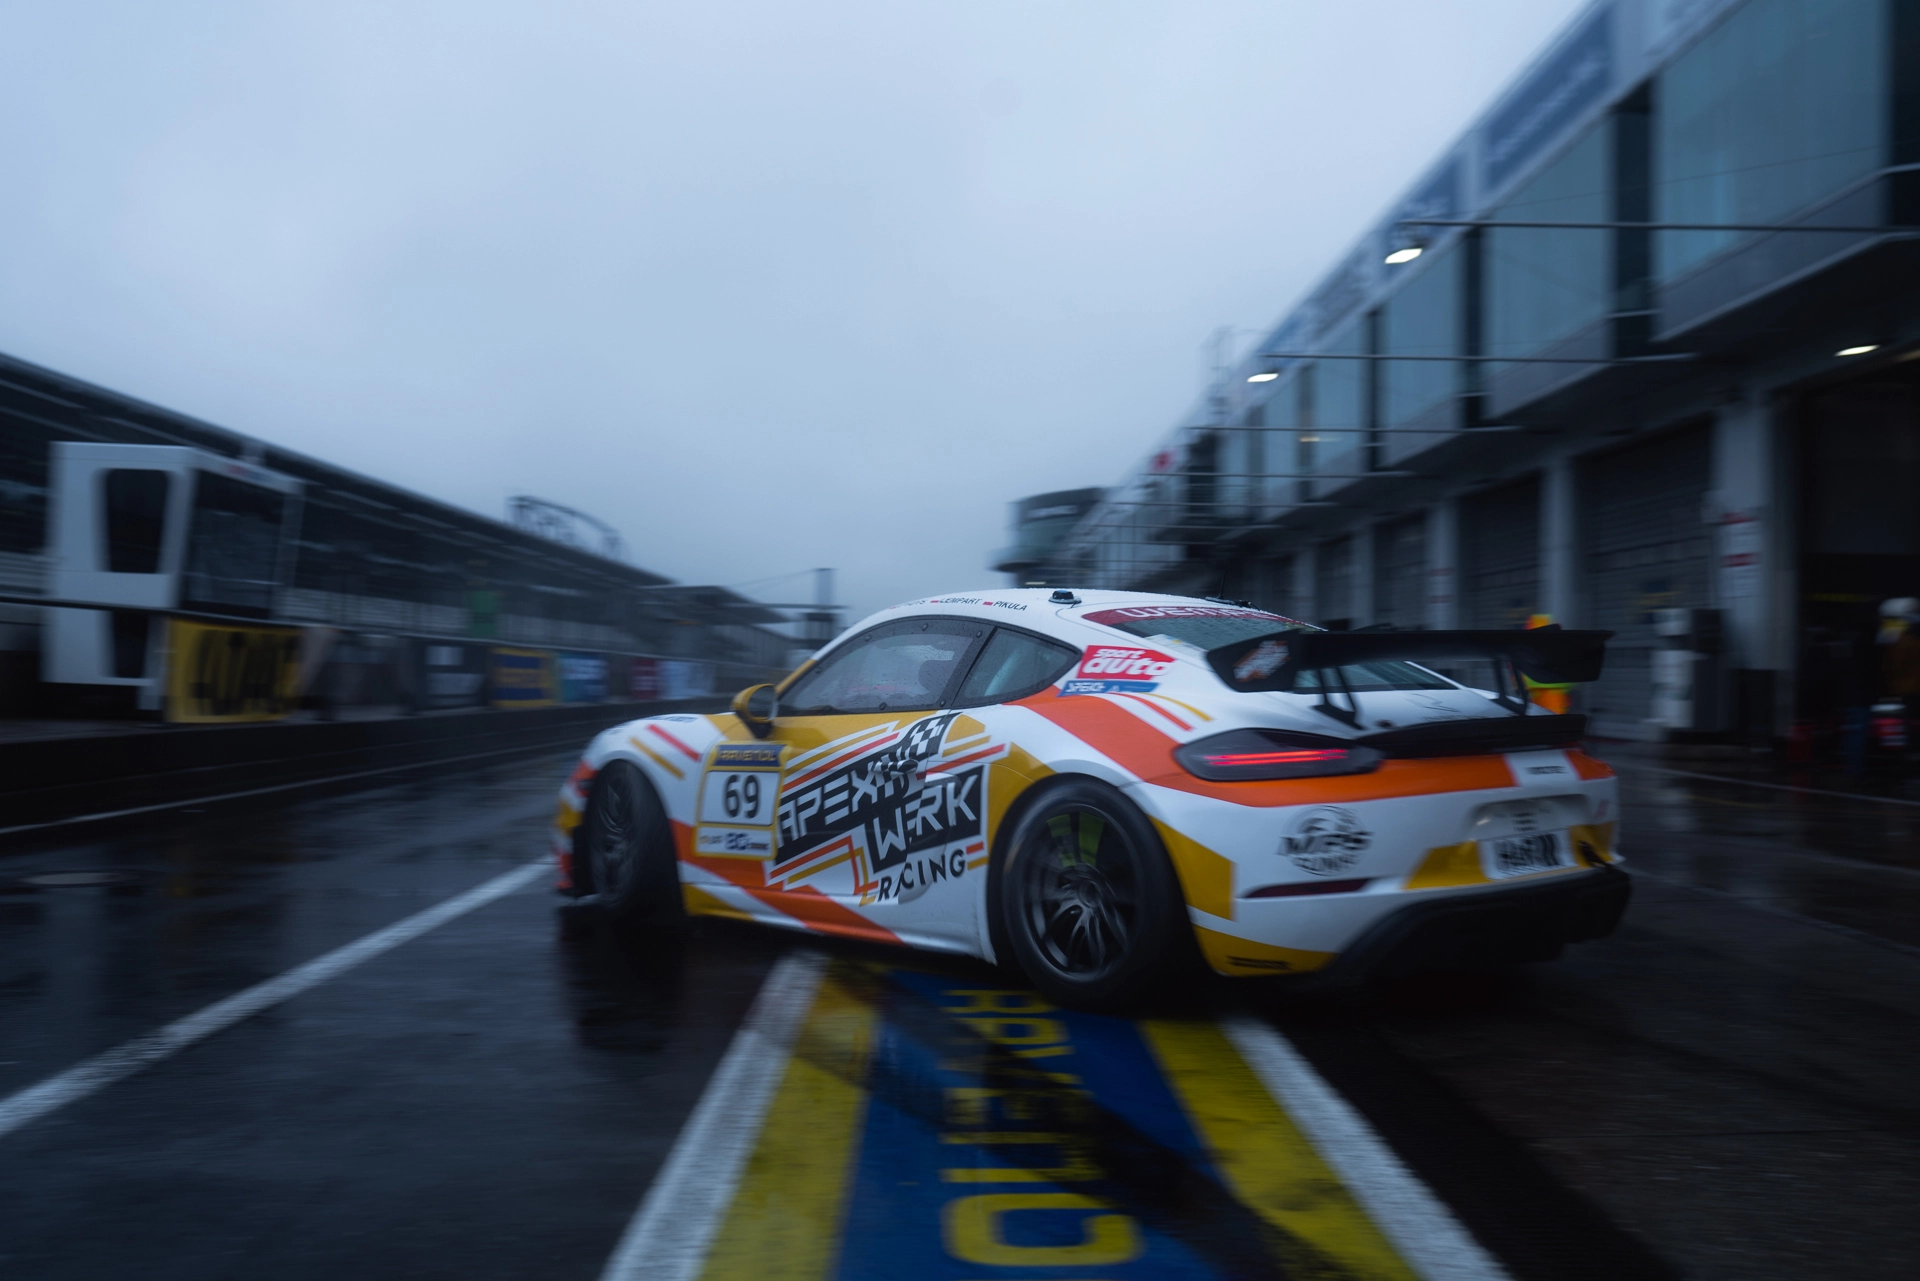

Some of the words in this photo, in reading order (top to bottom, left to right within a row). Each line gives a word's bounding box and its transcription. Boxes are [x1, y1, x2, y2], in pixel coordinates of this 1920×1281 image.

[1082, 658, 1171, 676] auto
[1093, 649, 1146, 660] sport
[724, 774, 760, 818] 69
[777, 761, 879, 847] APEX
[872, 774, 979, 862] WERK
[878, 848, 966, 904] RACING
